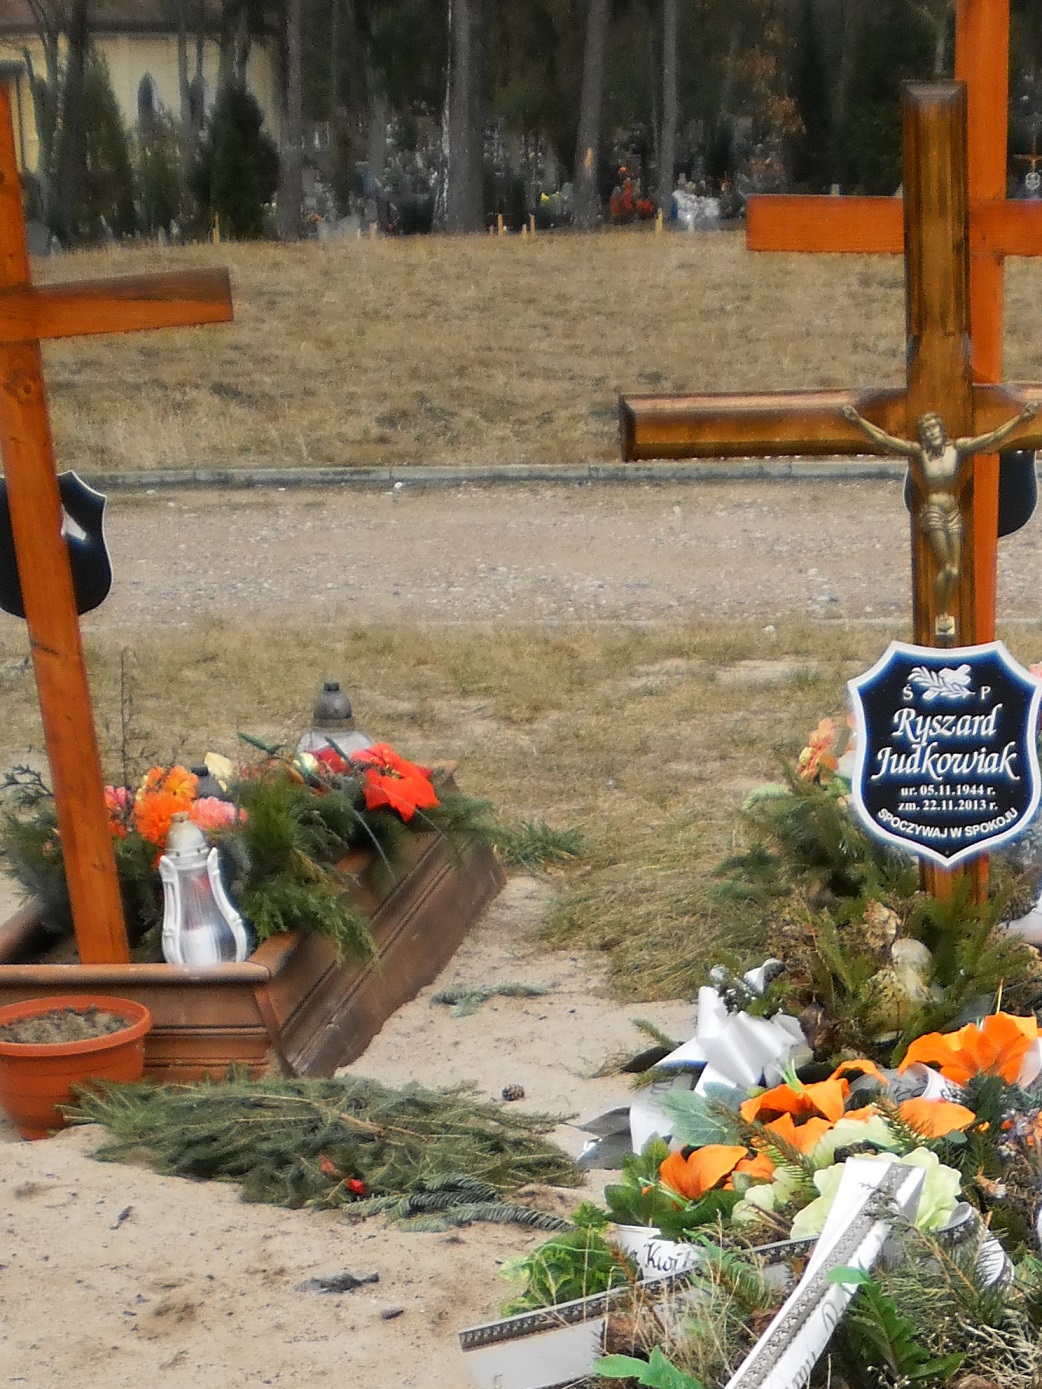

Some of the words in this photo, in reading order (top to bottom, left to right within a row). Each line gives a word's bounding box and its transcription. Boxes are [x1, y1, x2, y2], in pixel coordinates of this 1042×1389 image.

[903, 684, 914, 700] Ś
[981, 686, 991, 700] P
[892, 703, 1003, 744] Ryszard
[871, 741, 1020, 781] Judkowiak
[900, 786, 918, 796] ur.
[919, 784, 985, 796] 05.11.1944
[986, 786, 996, 796] r.
[898, 801, 920, 811] zm.
[922, 799, 987, 811] 22.11.2013
[989, 801, 999, 811] r.
[877, 808, 948, 838] SPOCZYWAJ
[949, 827, 963, 838] W
[964, 807, 1019, 837] SPOKOJU
